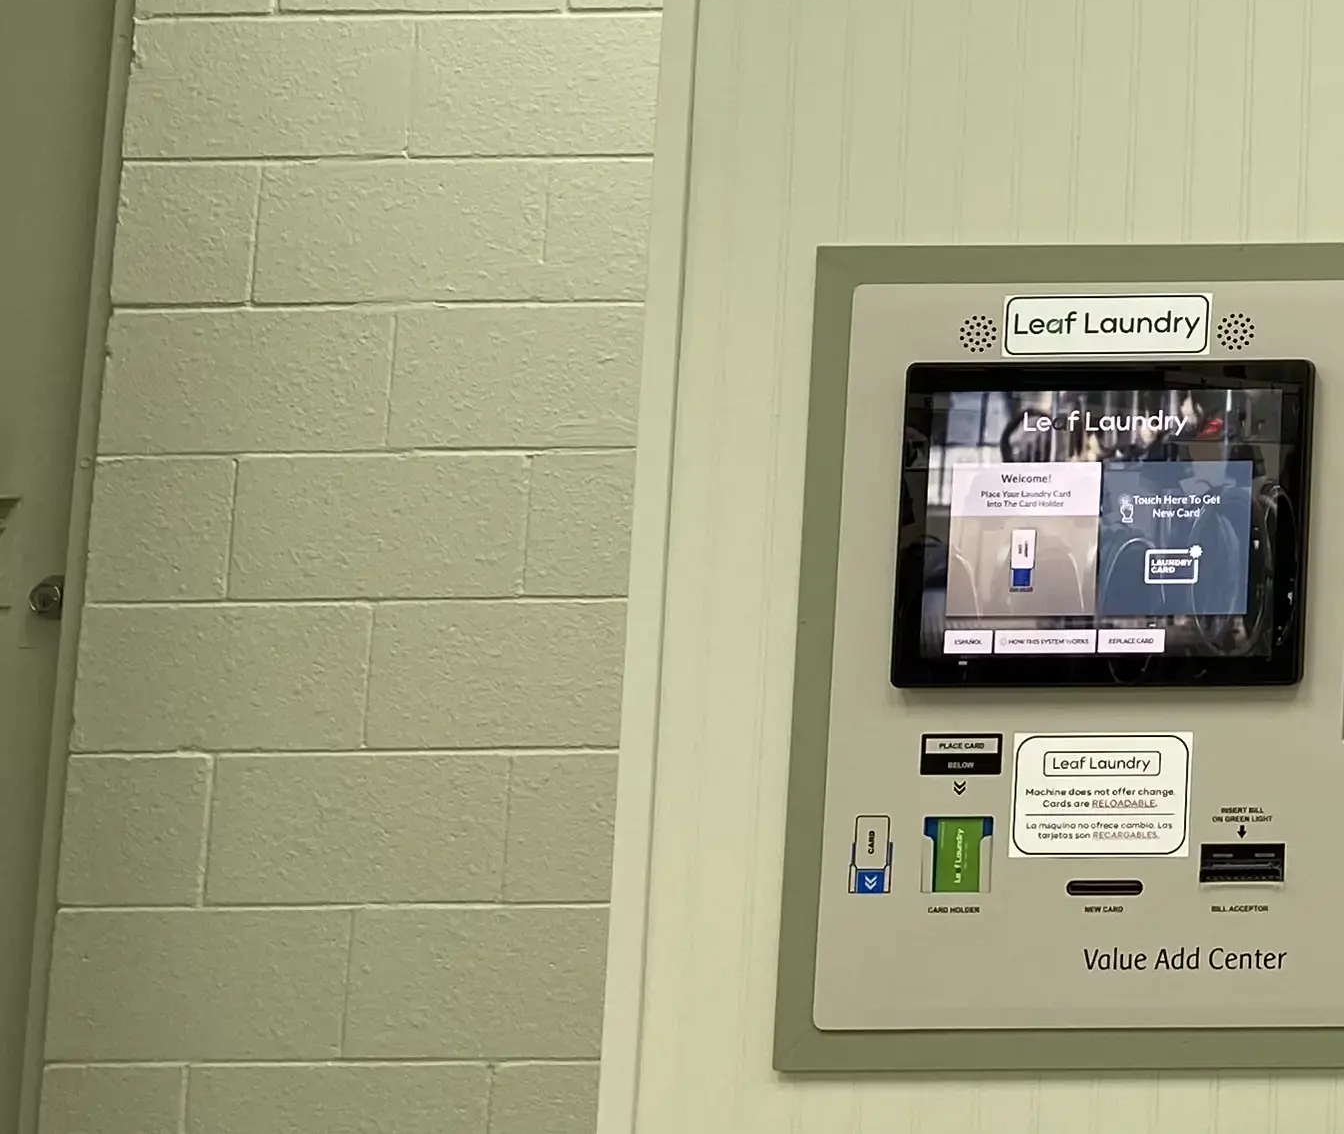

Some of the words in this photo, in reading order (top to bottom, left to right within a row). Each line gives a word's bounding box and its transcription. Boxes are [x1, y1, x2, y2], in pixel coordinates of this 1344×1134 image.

[1013, 311, 1077, 337] Leaf
[1084, 309, 1201, 340] Laundry
[1085, 410, 1188, 437] Laundry
[1001, 474, 1052, 483] Welcome!
[1133, 494, 1162, 505] Touch
[1163, 494, 1187, 505] Here
[1188, 494, 1201, 505] To
[1202, 494, 1221, 505] Get
[1153, 508, 1175, 518] New
[1176, 508, 1201, 518] Card
[1151, 566, 1175, 574] CARD
[947, 761, 975, 769] BELOW
[1052, 756, 1086, 770] Leaf
[1089, 756, 1151, 772] Laundry
[1025, 788, 1067, 796] Machine
[1068, 788, 1092, 796] does
[1094, 788, 1110, 796] not
[1112, 788, 1135, 796] offer
[1137, 788, 1176, 798] change.
[1042, 799, 1072, 808] Cards
[1091, 799, 1158, 808] RELOADABLE.
[867, 830, 876, 855] CARD
[955, 828, 965, 864] Laundry
[927, 906, 948, 914] CARD
[950, 906, 980, 914] HOLDER
[1084, 905, 1101, 913] NEW
[1103, 905, 1124, 913] CARD
[1211, 905, 1227, 913] BILL
[1229, 905, 1269, 913] ACCEPTOR
[1083, 947, 1147, 971] Value
[1154, 947, 1200, 971] Add
[1208, 947, 1288, 971] Center
